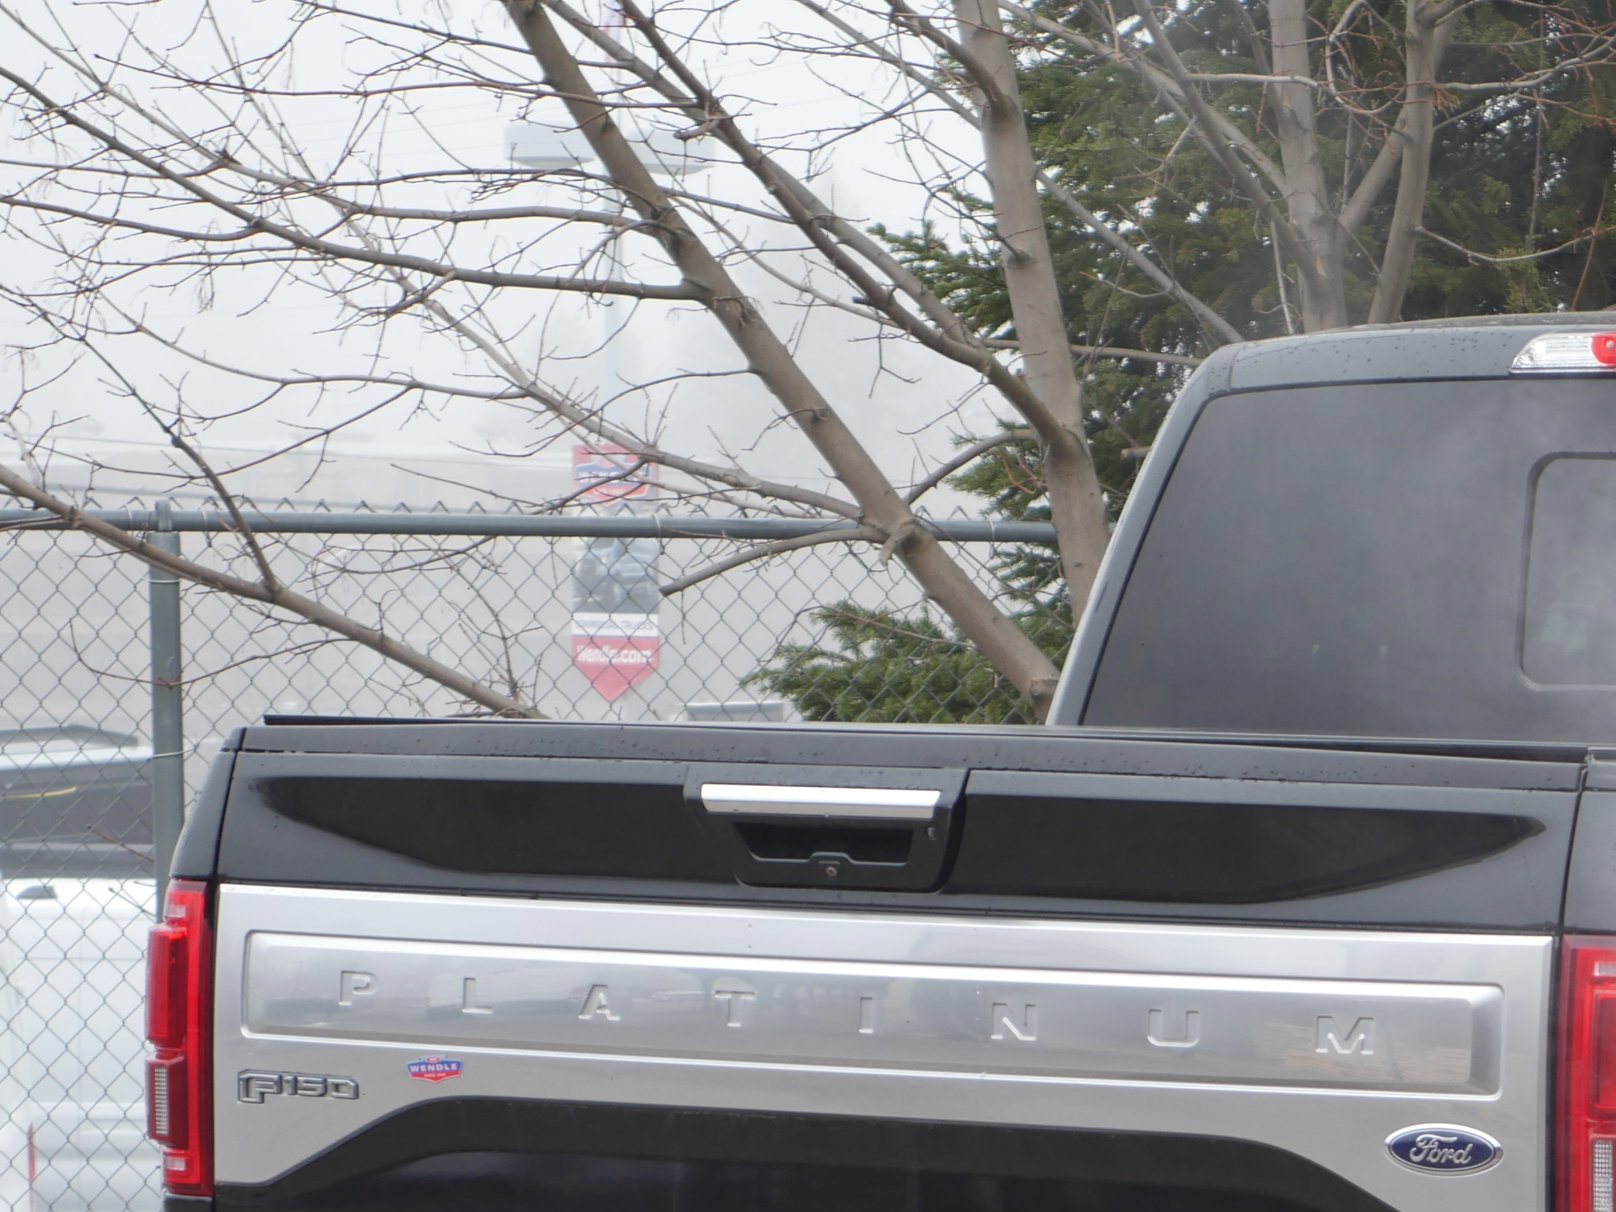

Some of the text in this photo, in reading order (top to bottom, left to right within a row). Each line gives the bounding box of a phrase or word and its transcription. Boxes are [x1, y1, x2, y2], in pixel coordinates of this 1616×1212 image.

[338, 969, 1375, 1056] PLATINUM
[410, 1062, 457, 1072] WENDLE
[1409, 1133, 1473, 1164] Ford
